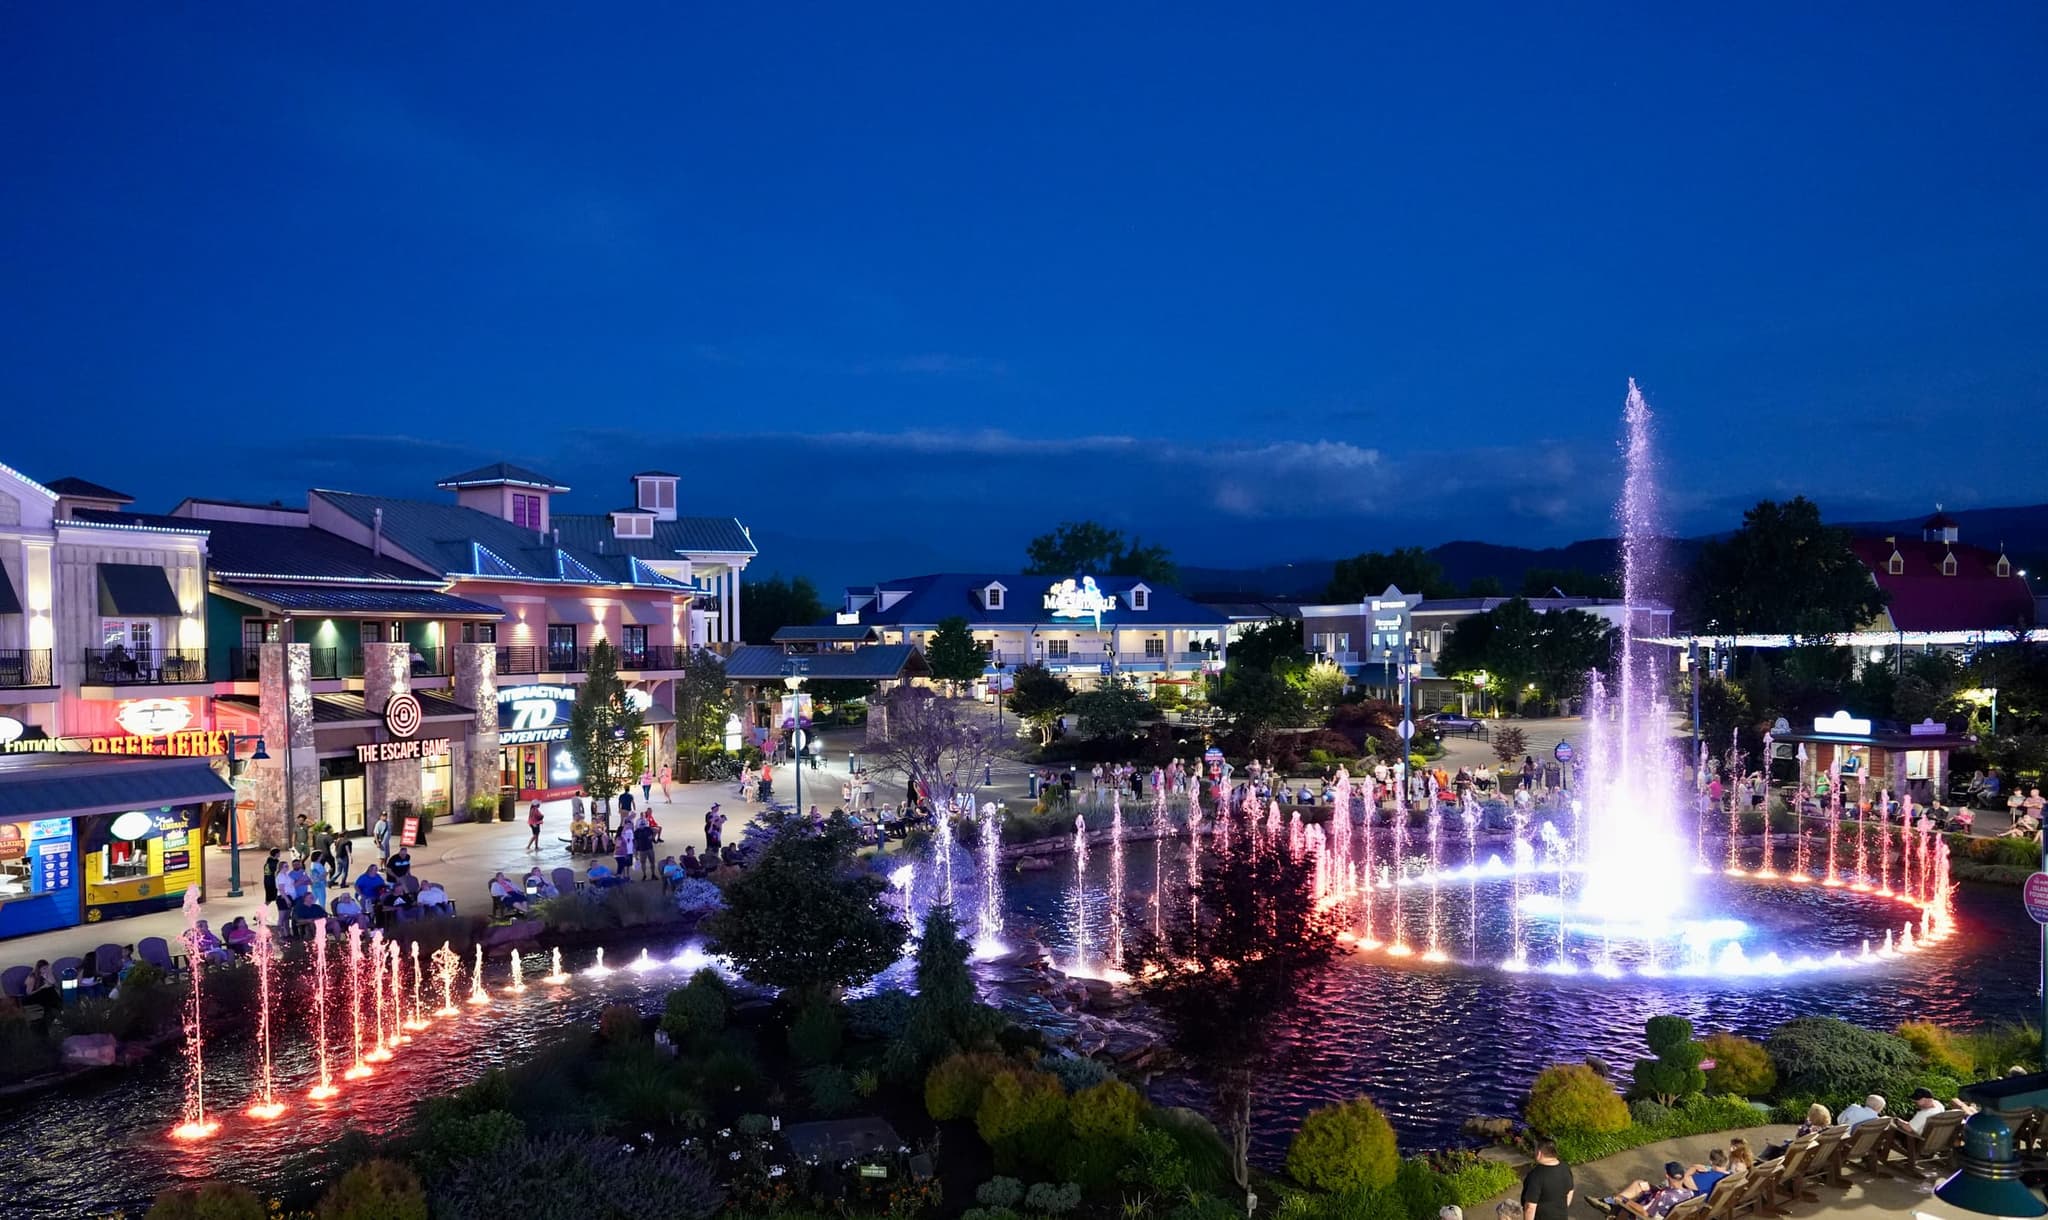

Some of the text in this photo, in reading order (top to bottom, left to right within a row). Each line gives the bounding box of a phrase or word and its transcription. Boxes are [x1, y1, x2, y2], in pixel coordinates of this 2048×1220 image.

[496, 685, 576, 702] NTERACTIVE
[512, 699, 558, 731] 7D
[356, 738, 450, 763] THE ESCAPE GAME
